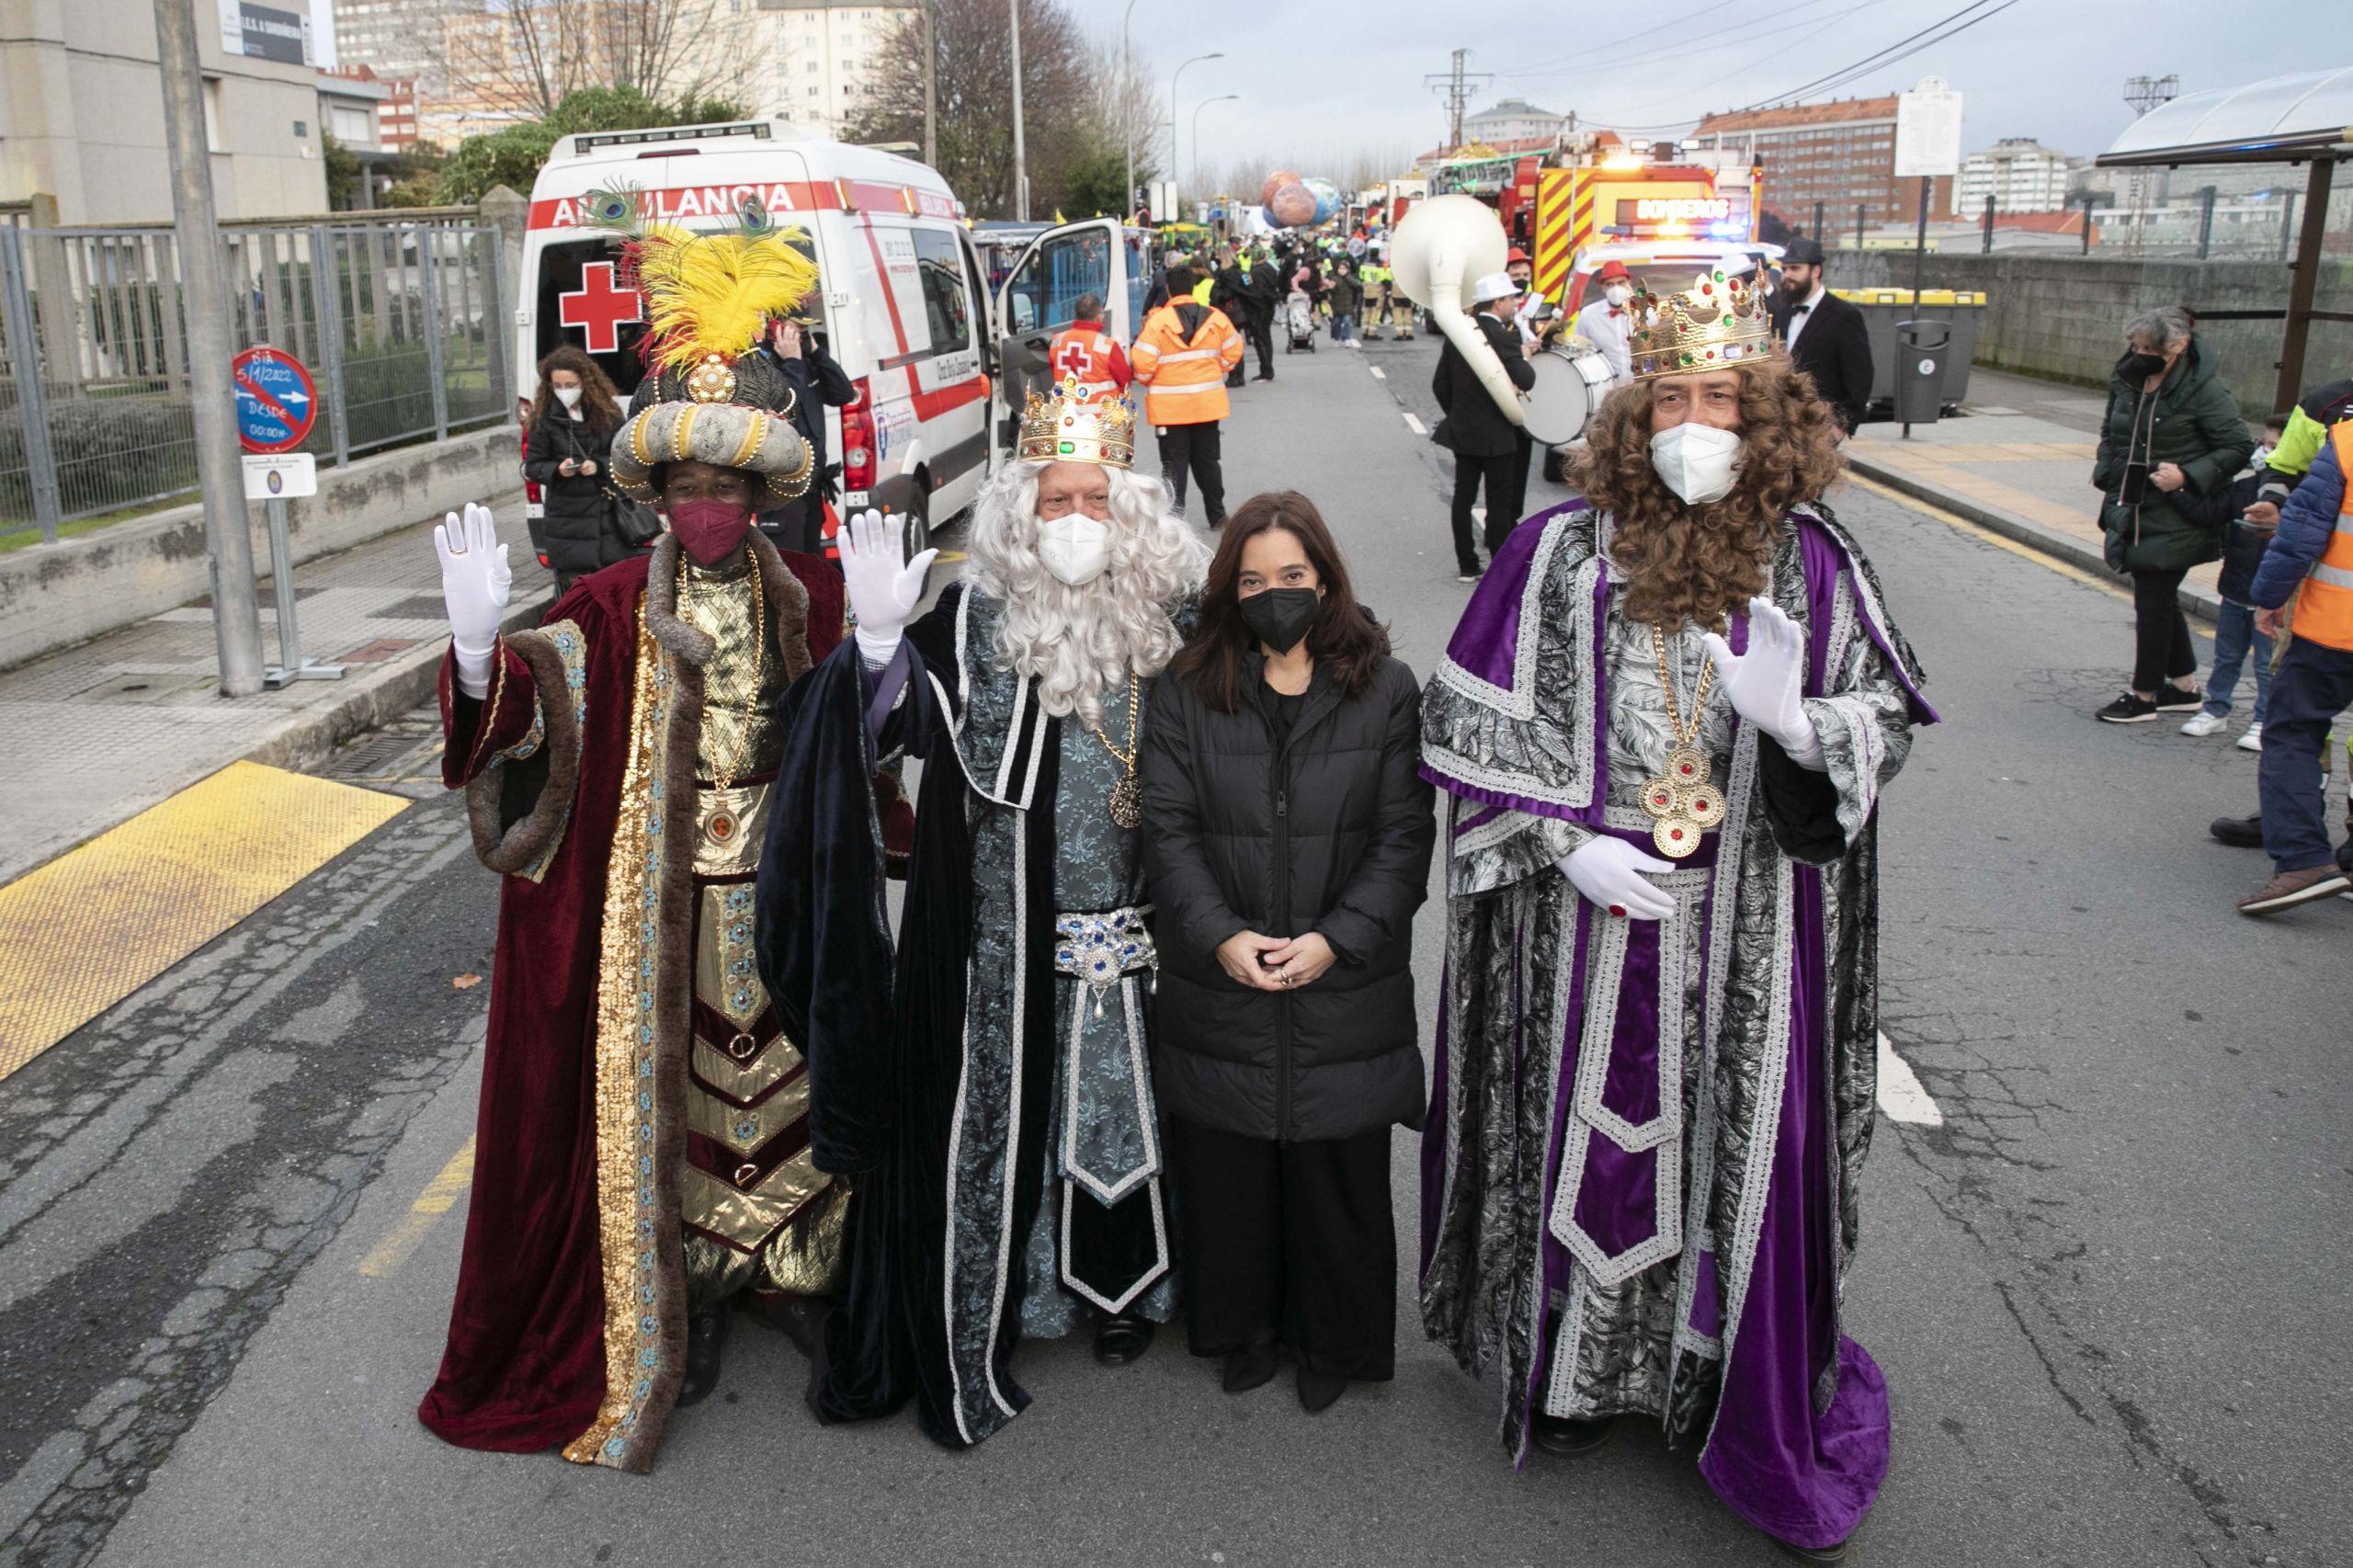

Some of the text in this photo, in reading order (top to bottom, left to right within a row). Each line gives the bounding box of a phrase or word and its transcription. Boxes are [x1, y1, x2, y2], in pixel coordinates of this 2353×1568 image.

[552, 183, 794, 226] AULANCIA
[1637, 199, 1729, 220] BOMBEROS
[249, 402, 288, 418] DESDE
